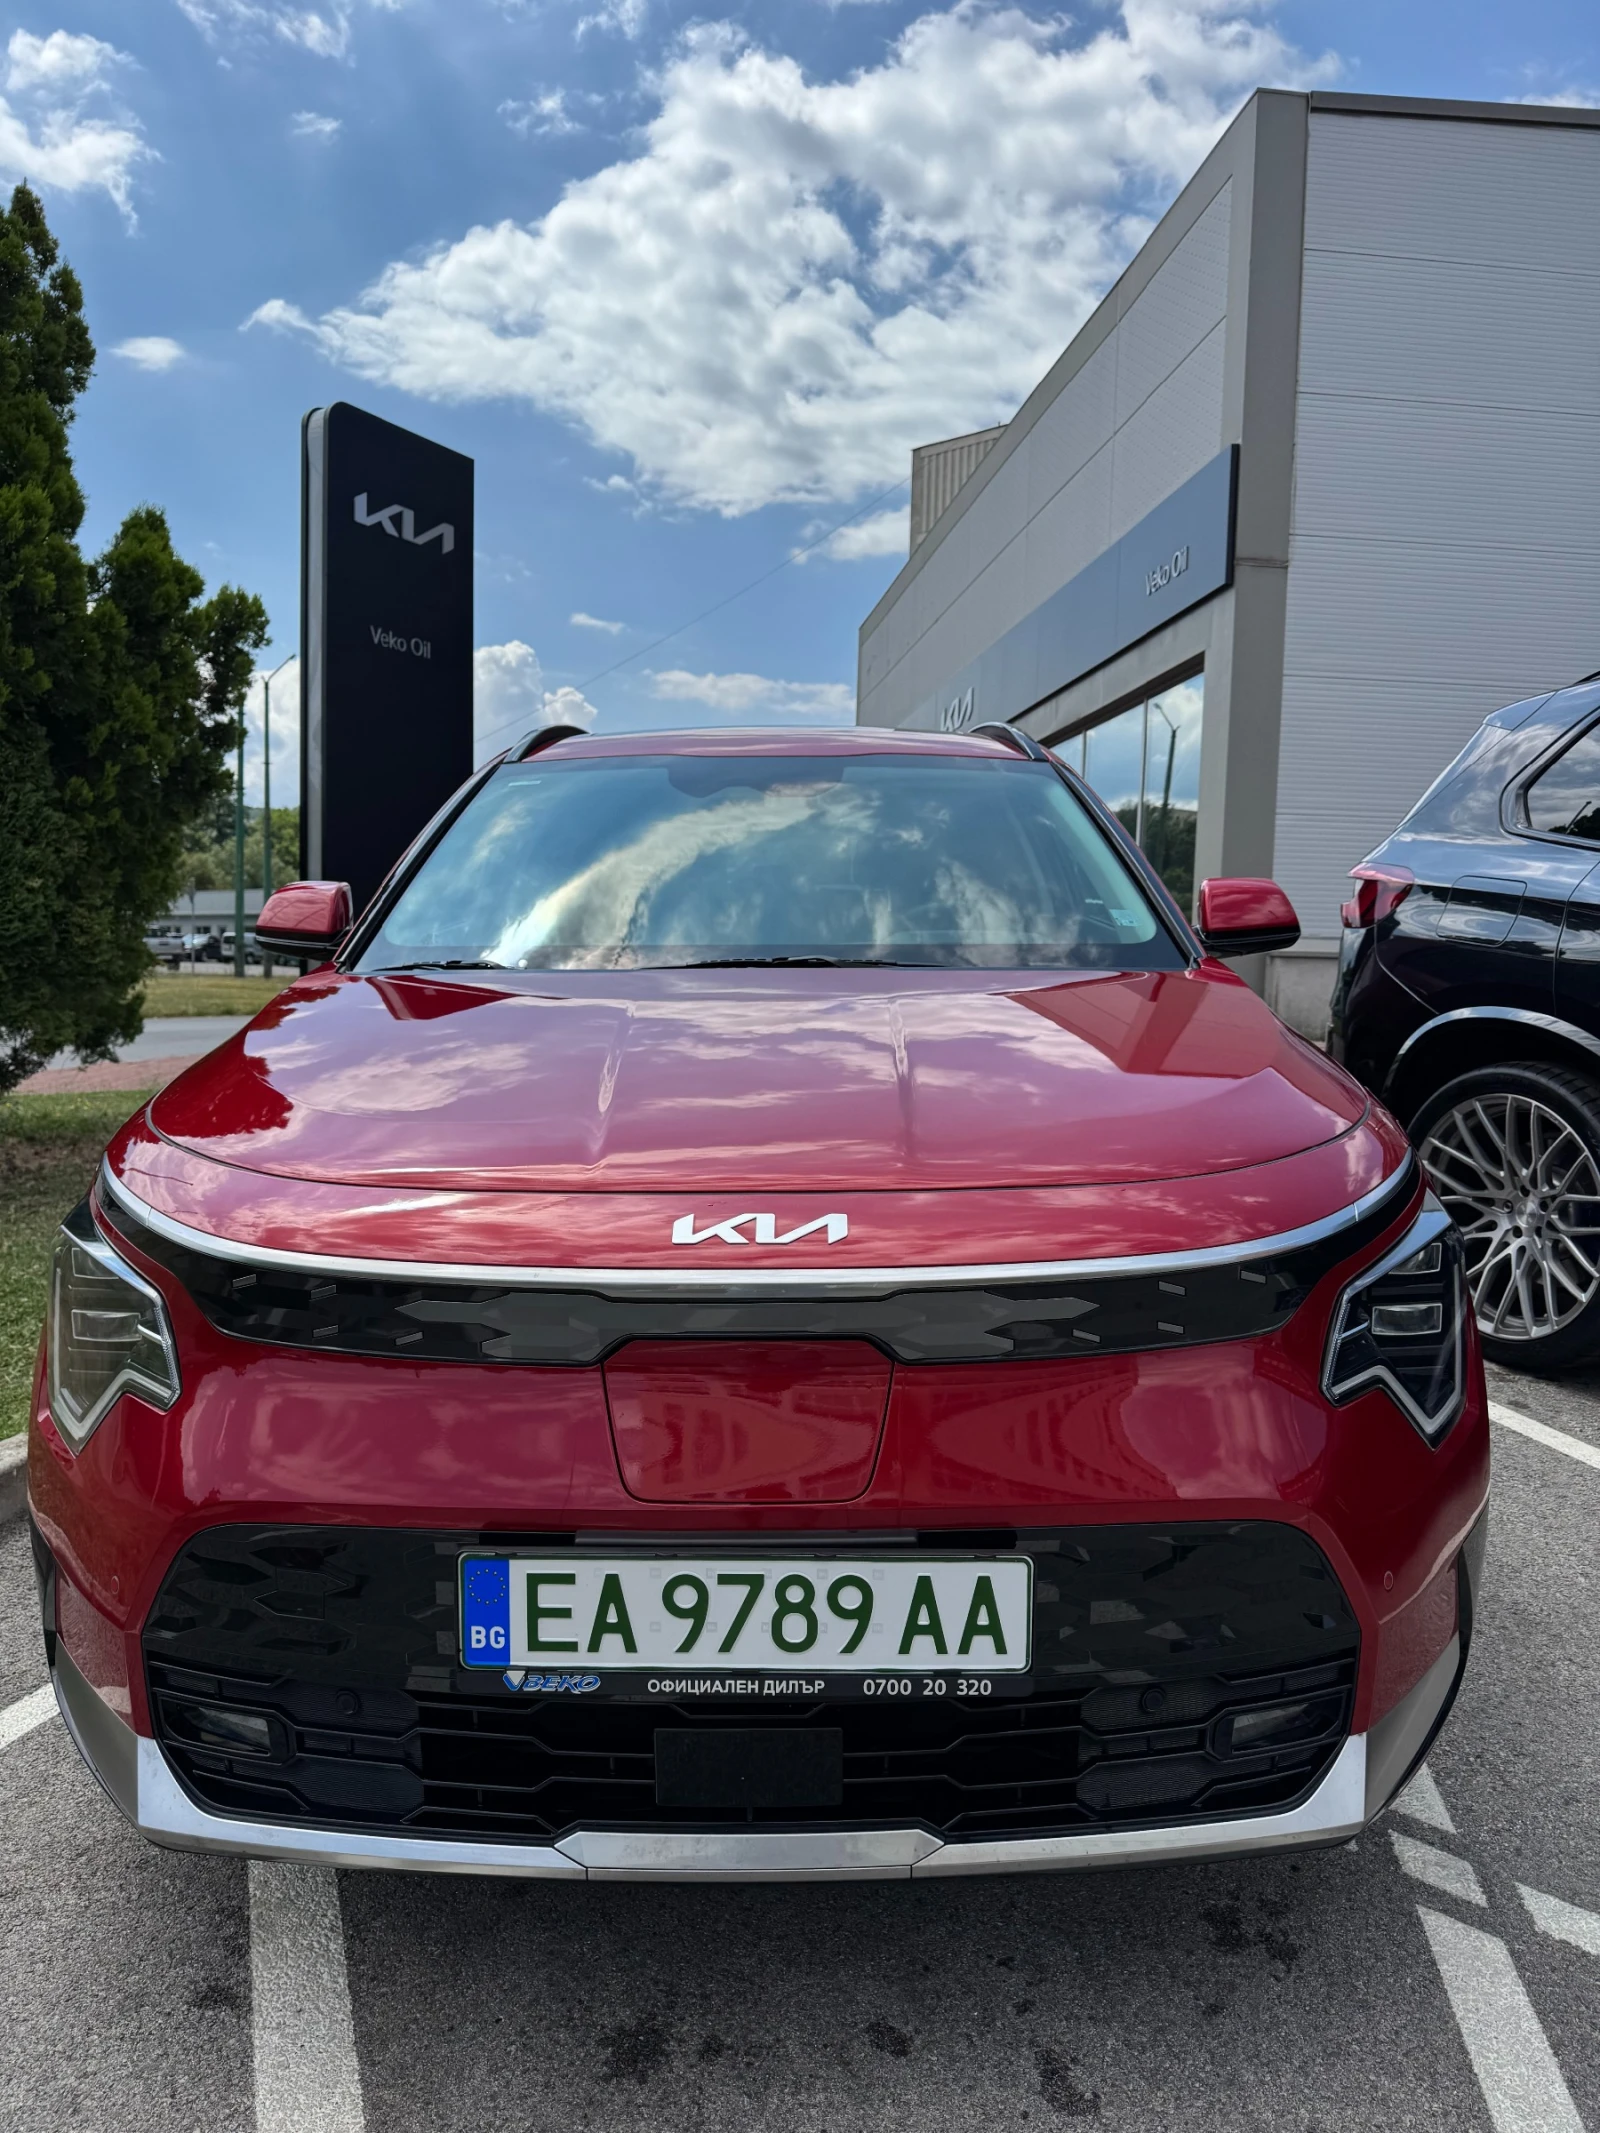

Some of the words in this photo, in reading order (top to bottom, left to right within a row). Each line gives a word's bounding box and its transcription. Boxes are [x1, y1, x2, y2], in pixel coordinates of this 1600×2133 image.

[369, 625, 407, 652] Veko
[411, 637, 431, 659] Oil
[526, 1571, 638, 1653] EA
[661, 1571, 874, 1654] 9789
[897, 1573, 1008, 1655] AA
[470, 1625, 506, 1649] BG
[647, 1679, 759, 1695] ОФИЦИАЛЕН
[763, 1679, 825, 1696] ДИЛЪР
[863, 1679, 912, 1696] 0700
[922, 1679, 947, 1696] 20
[956, 1679, 992, 1696] 320
